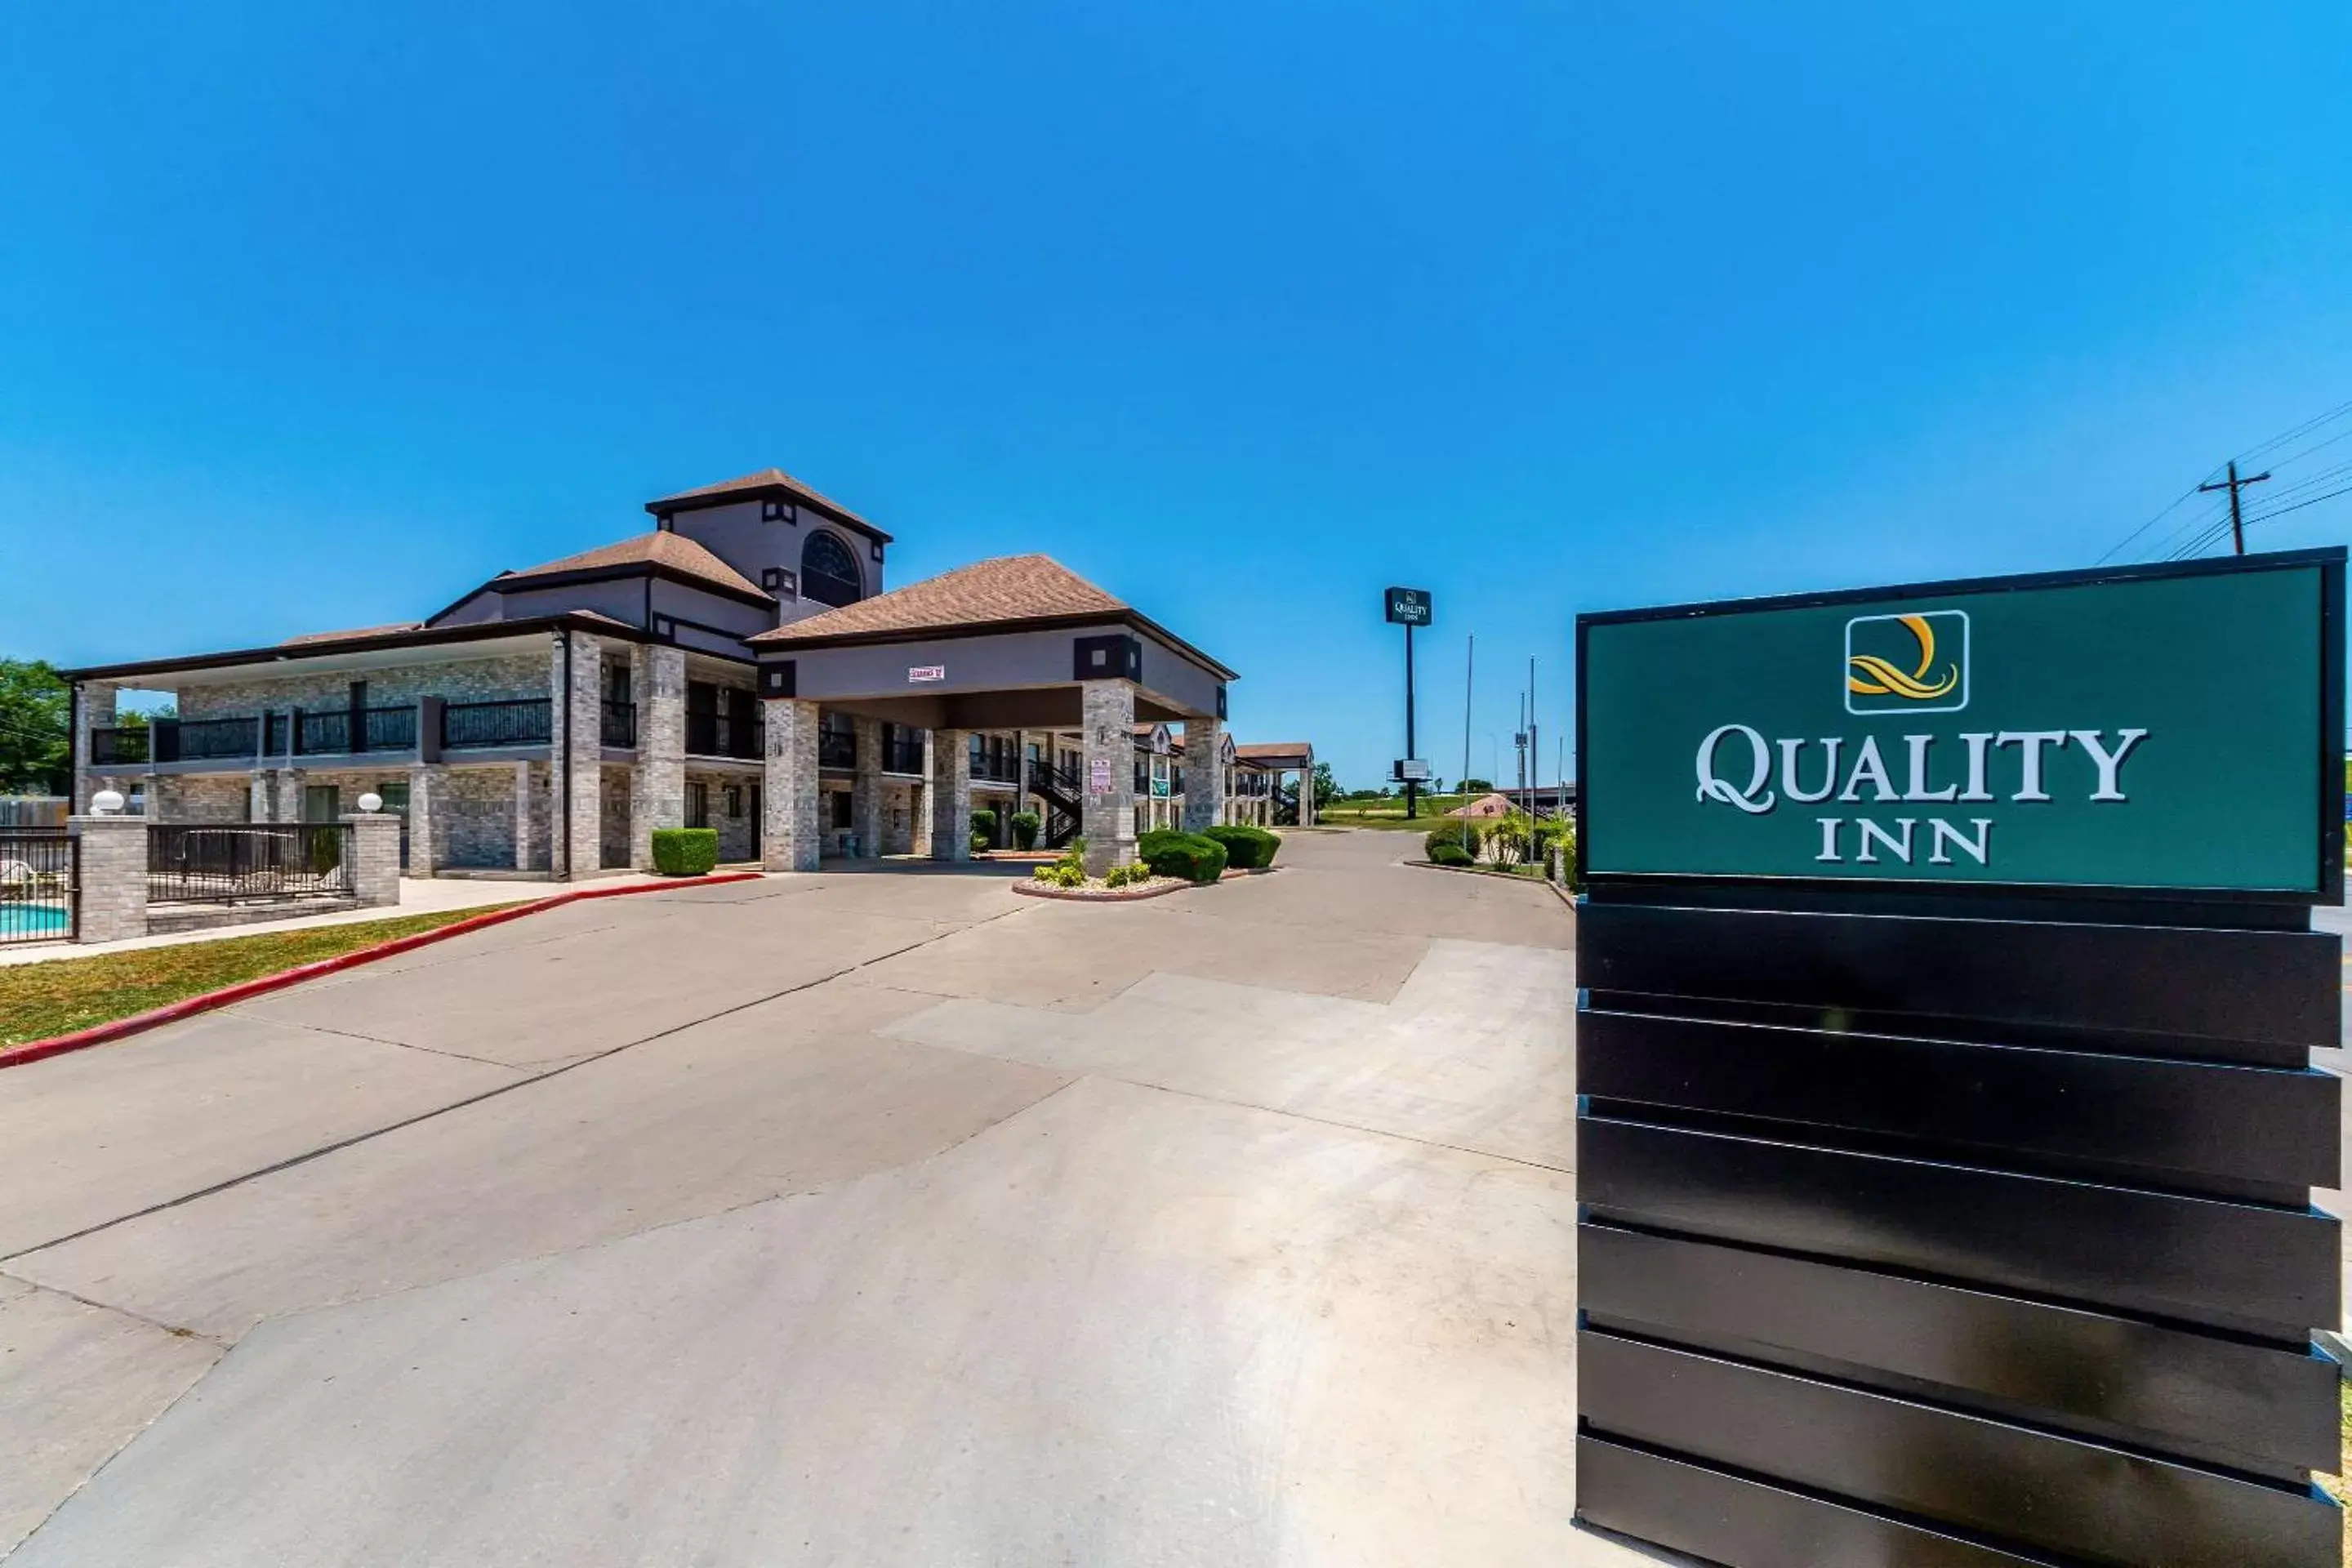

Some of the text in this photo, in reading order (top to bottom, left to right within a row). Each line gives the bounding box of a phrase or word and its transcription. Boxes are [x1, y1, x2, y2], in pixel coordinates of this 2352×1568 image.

[1395, 601, 1428, 615] QUALITY
[1695, 724, 2148, 813] QUALITY
[1815, 817, 1993, 864] INN
